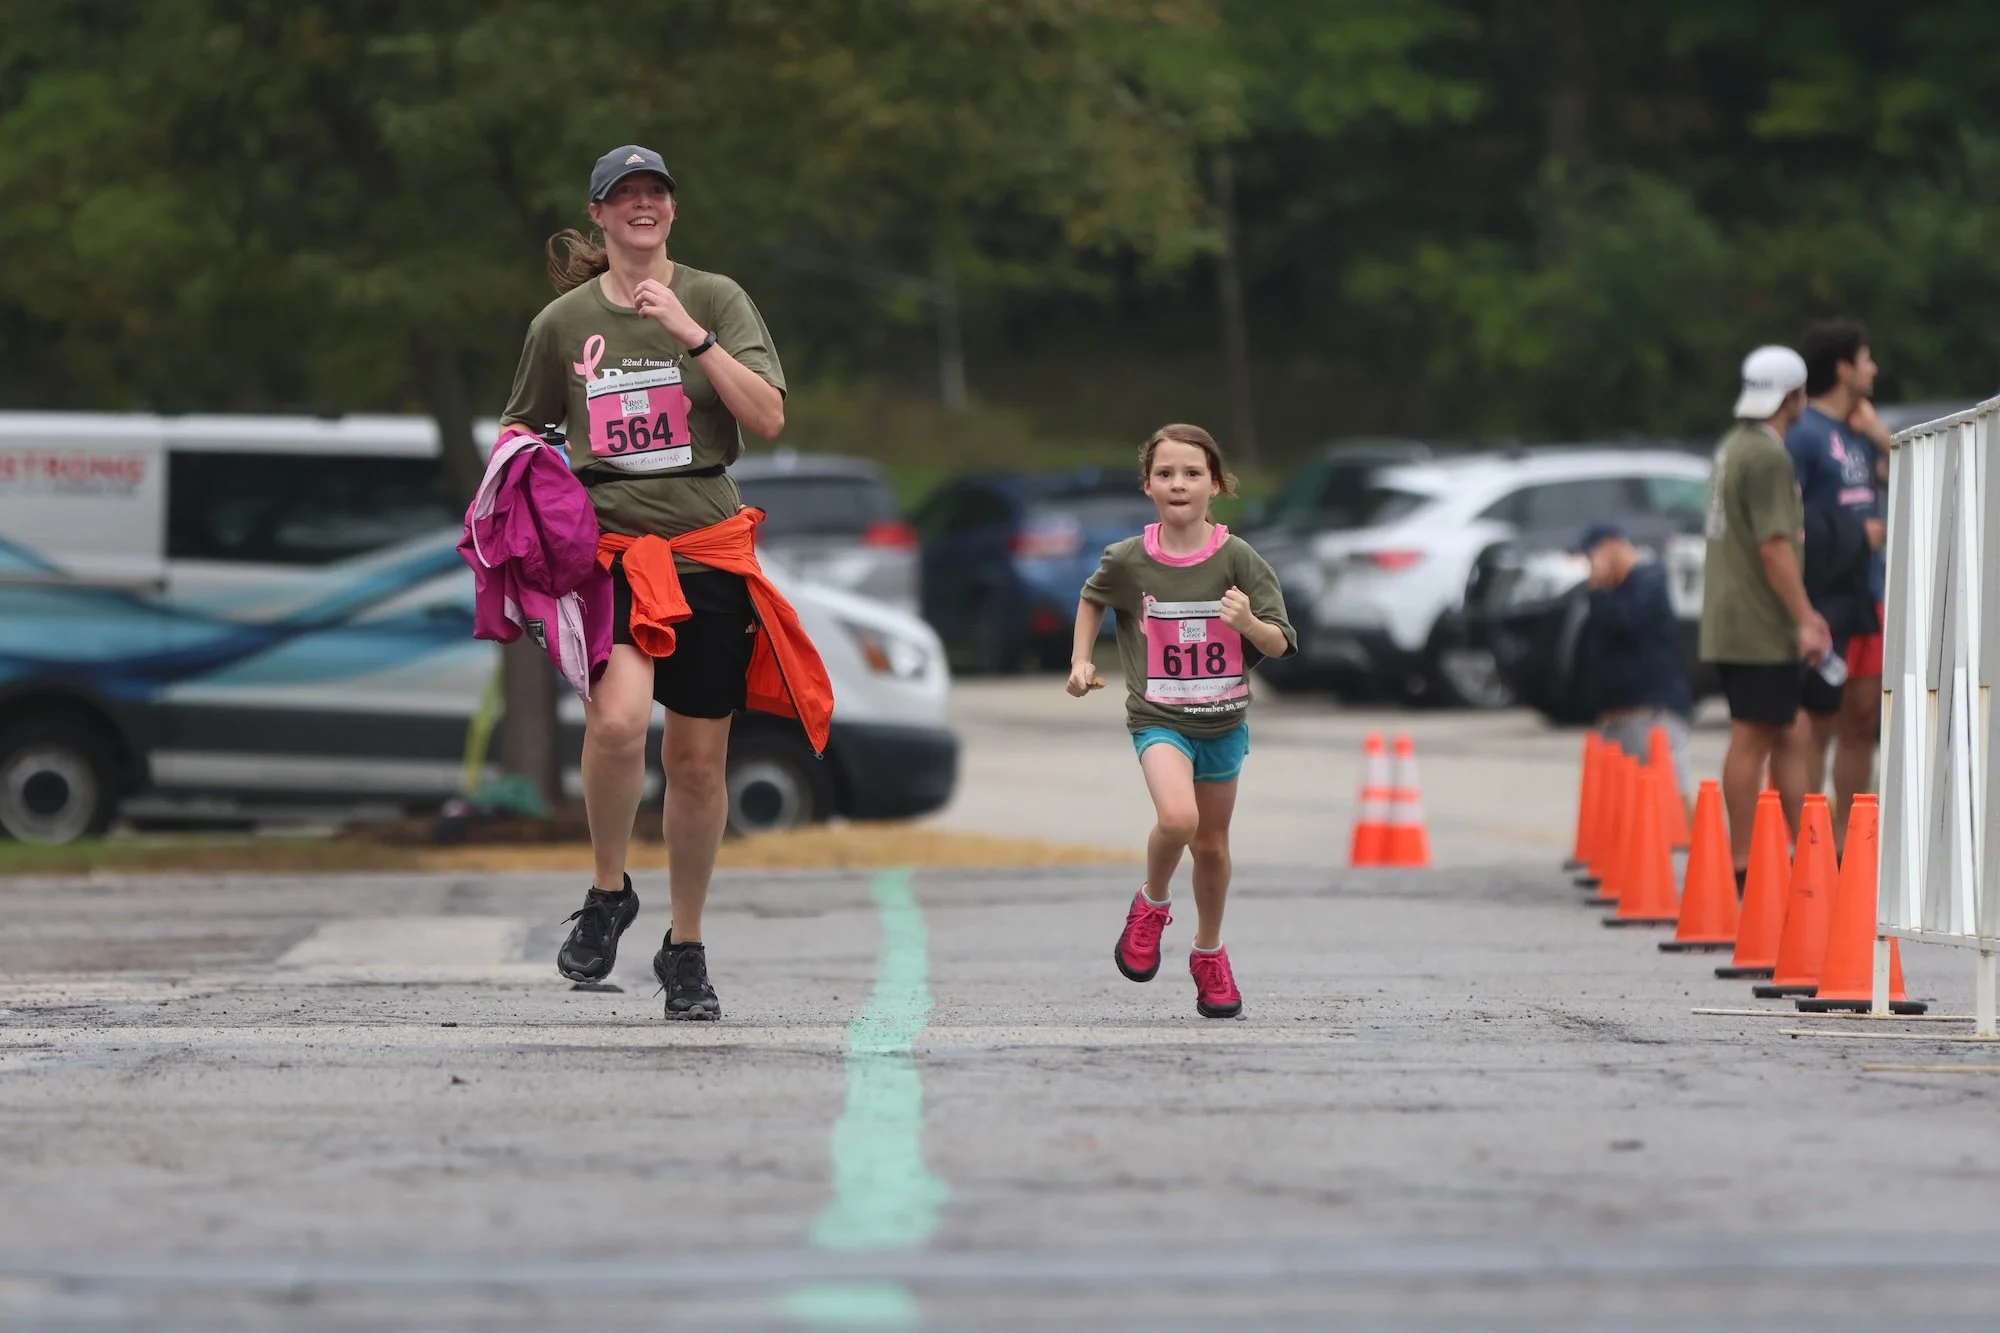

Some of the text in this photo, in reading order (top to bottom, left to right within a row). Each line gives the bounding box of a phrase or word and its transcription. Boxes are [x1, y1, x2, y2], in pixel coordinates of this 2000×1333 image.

[622, 358, 673, 367] 22nd Annual
[629, 399, 645, 407] Race
[625, 404, 644, 412] Grace
[606, 412, 673, 453] 564
[1163, 642, 1226, 676] 618
[1184, 705, 1224, 714] September
